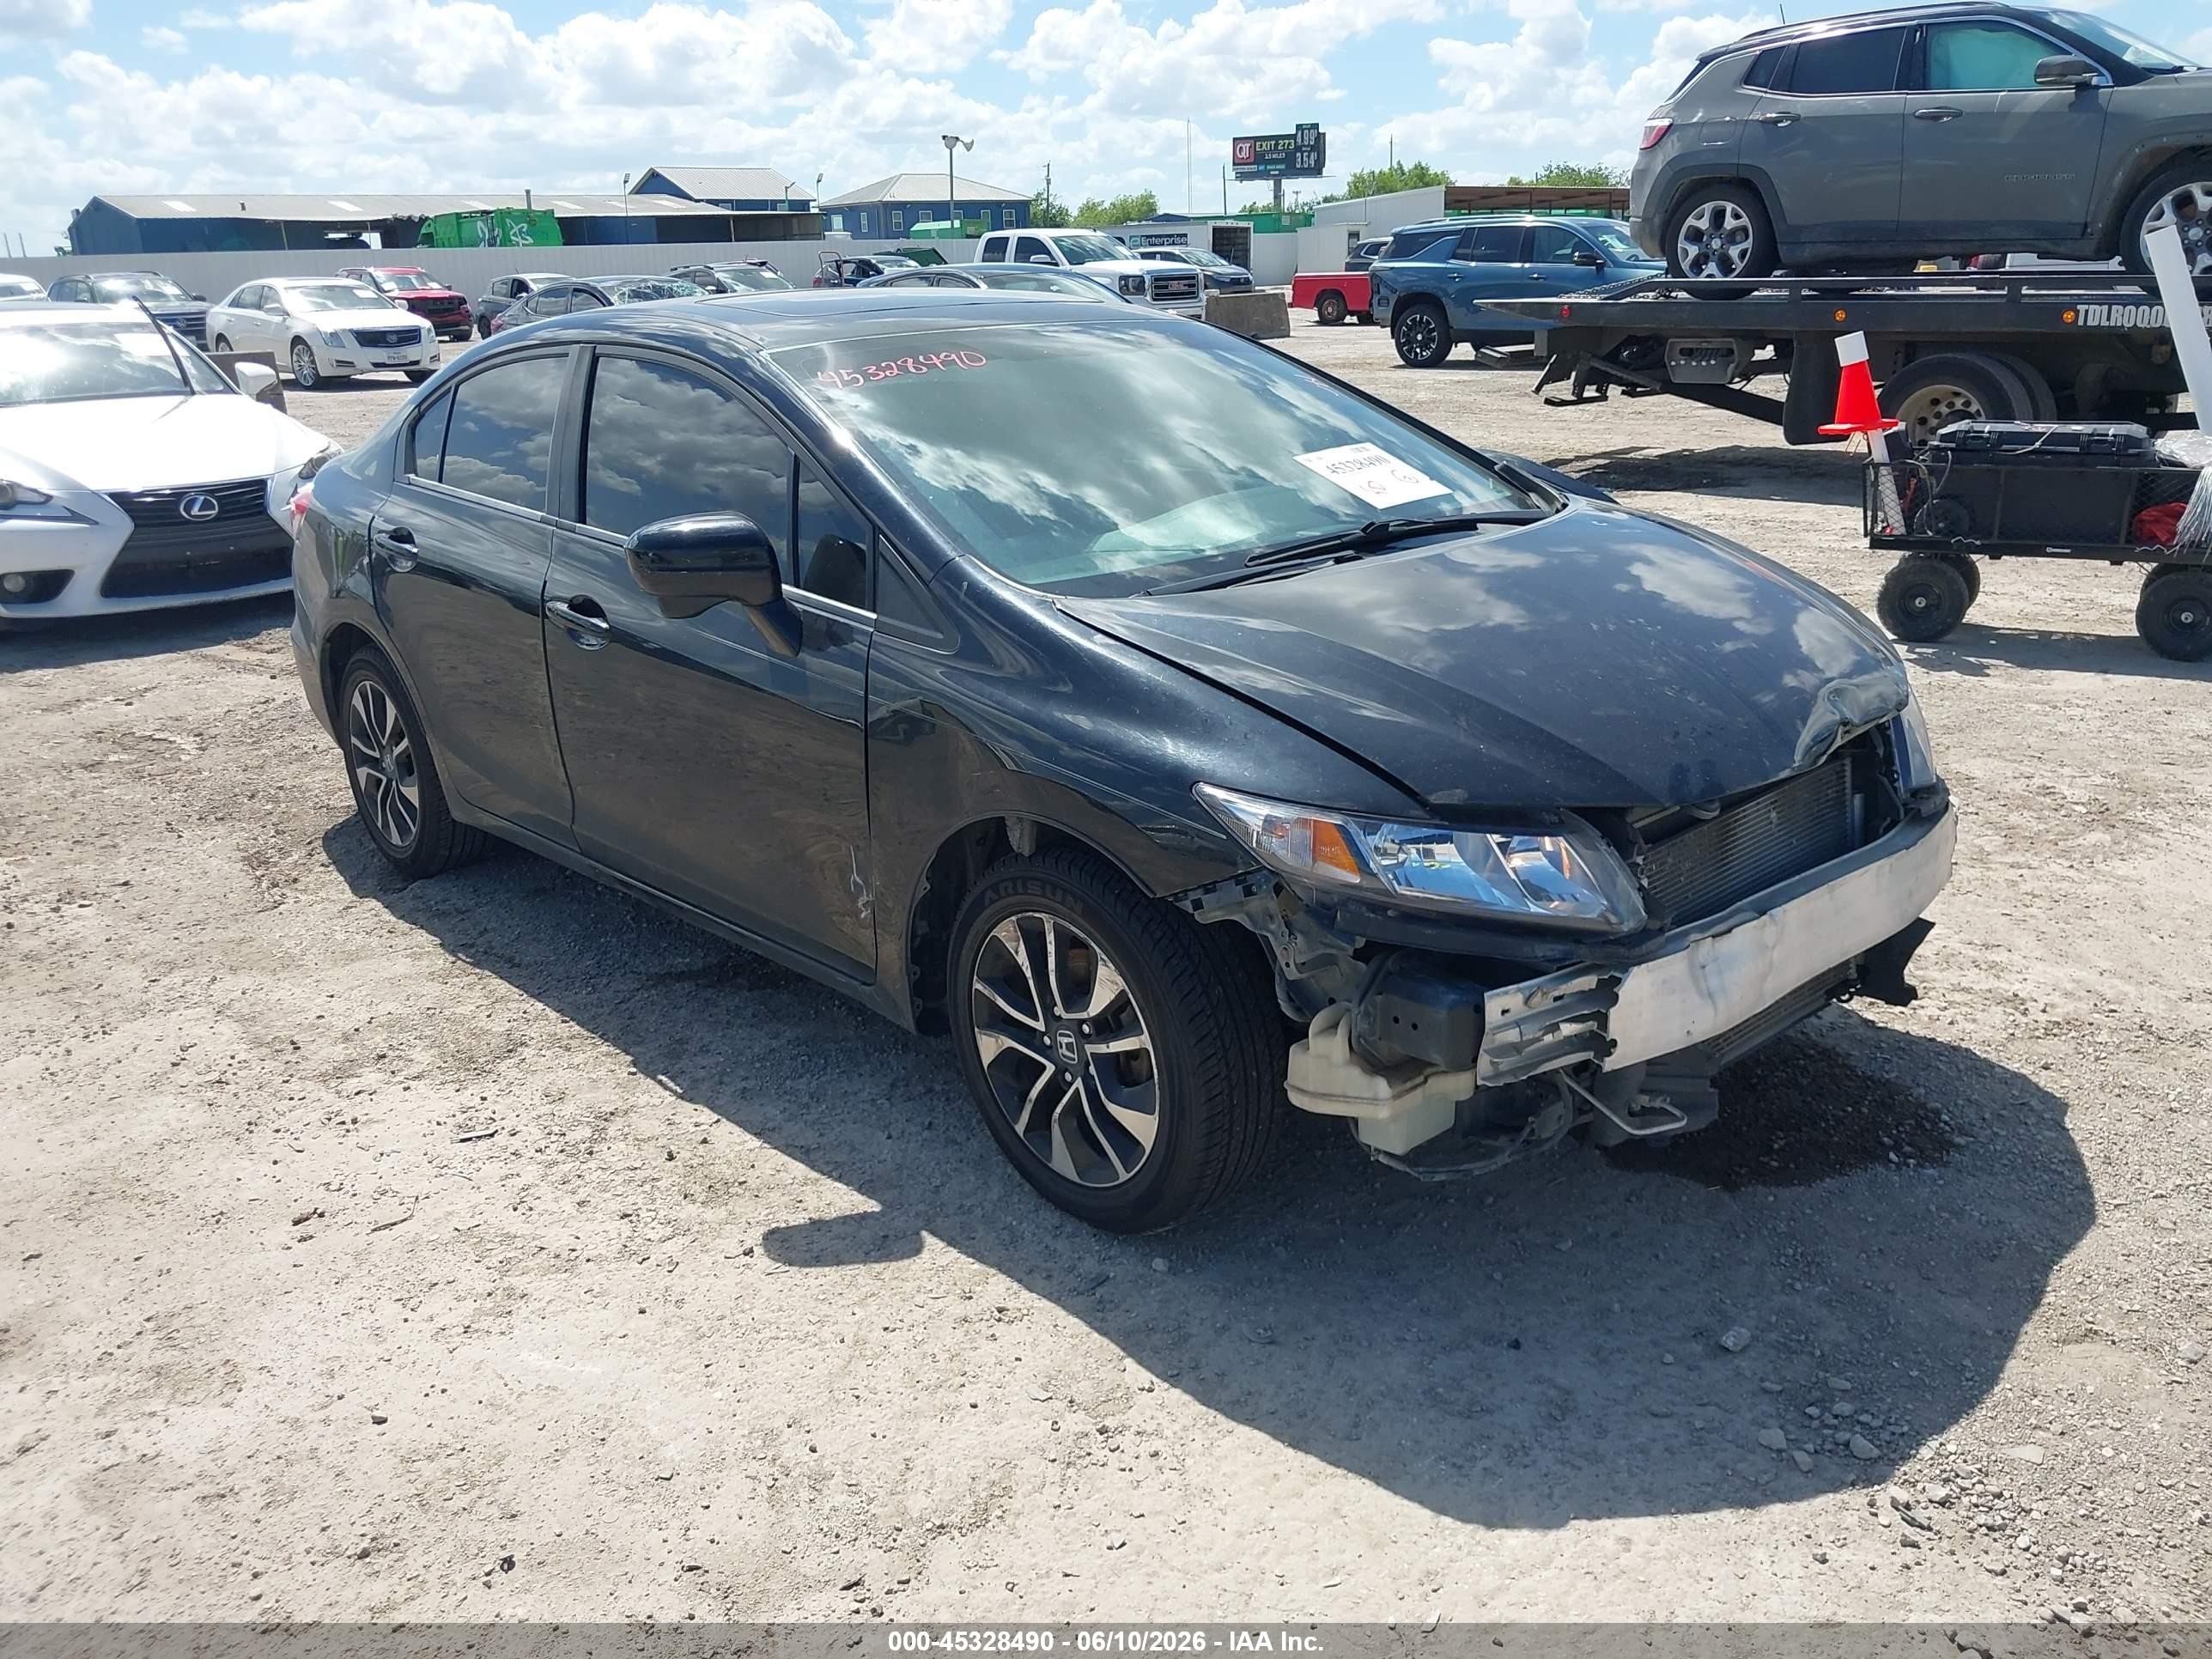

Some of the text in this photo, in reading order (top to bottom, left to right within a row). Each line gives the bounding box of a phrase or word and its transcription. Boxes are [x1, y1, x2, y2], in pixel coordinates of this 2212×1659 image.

[1237, 143, 1251, 160] QT
[1255, 139, 1295, 151] EXIT 273
[1141, 234, 1188, 246] Enterprise
[816, 349, 987, 389] 45328490
[984, 878, 1084, 914] ARISUN
